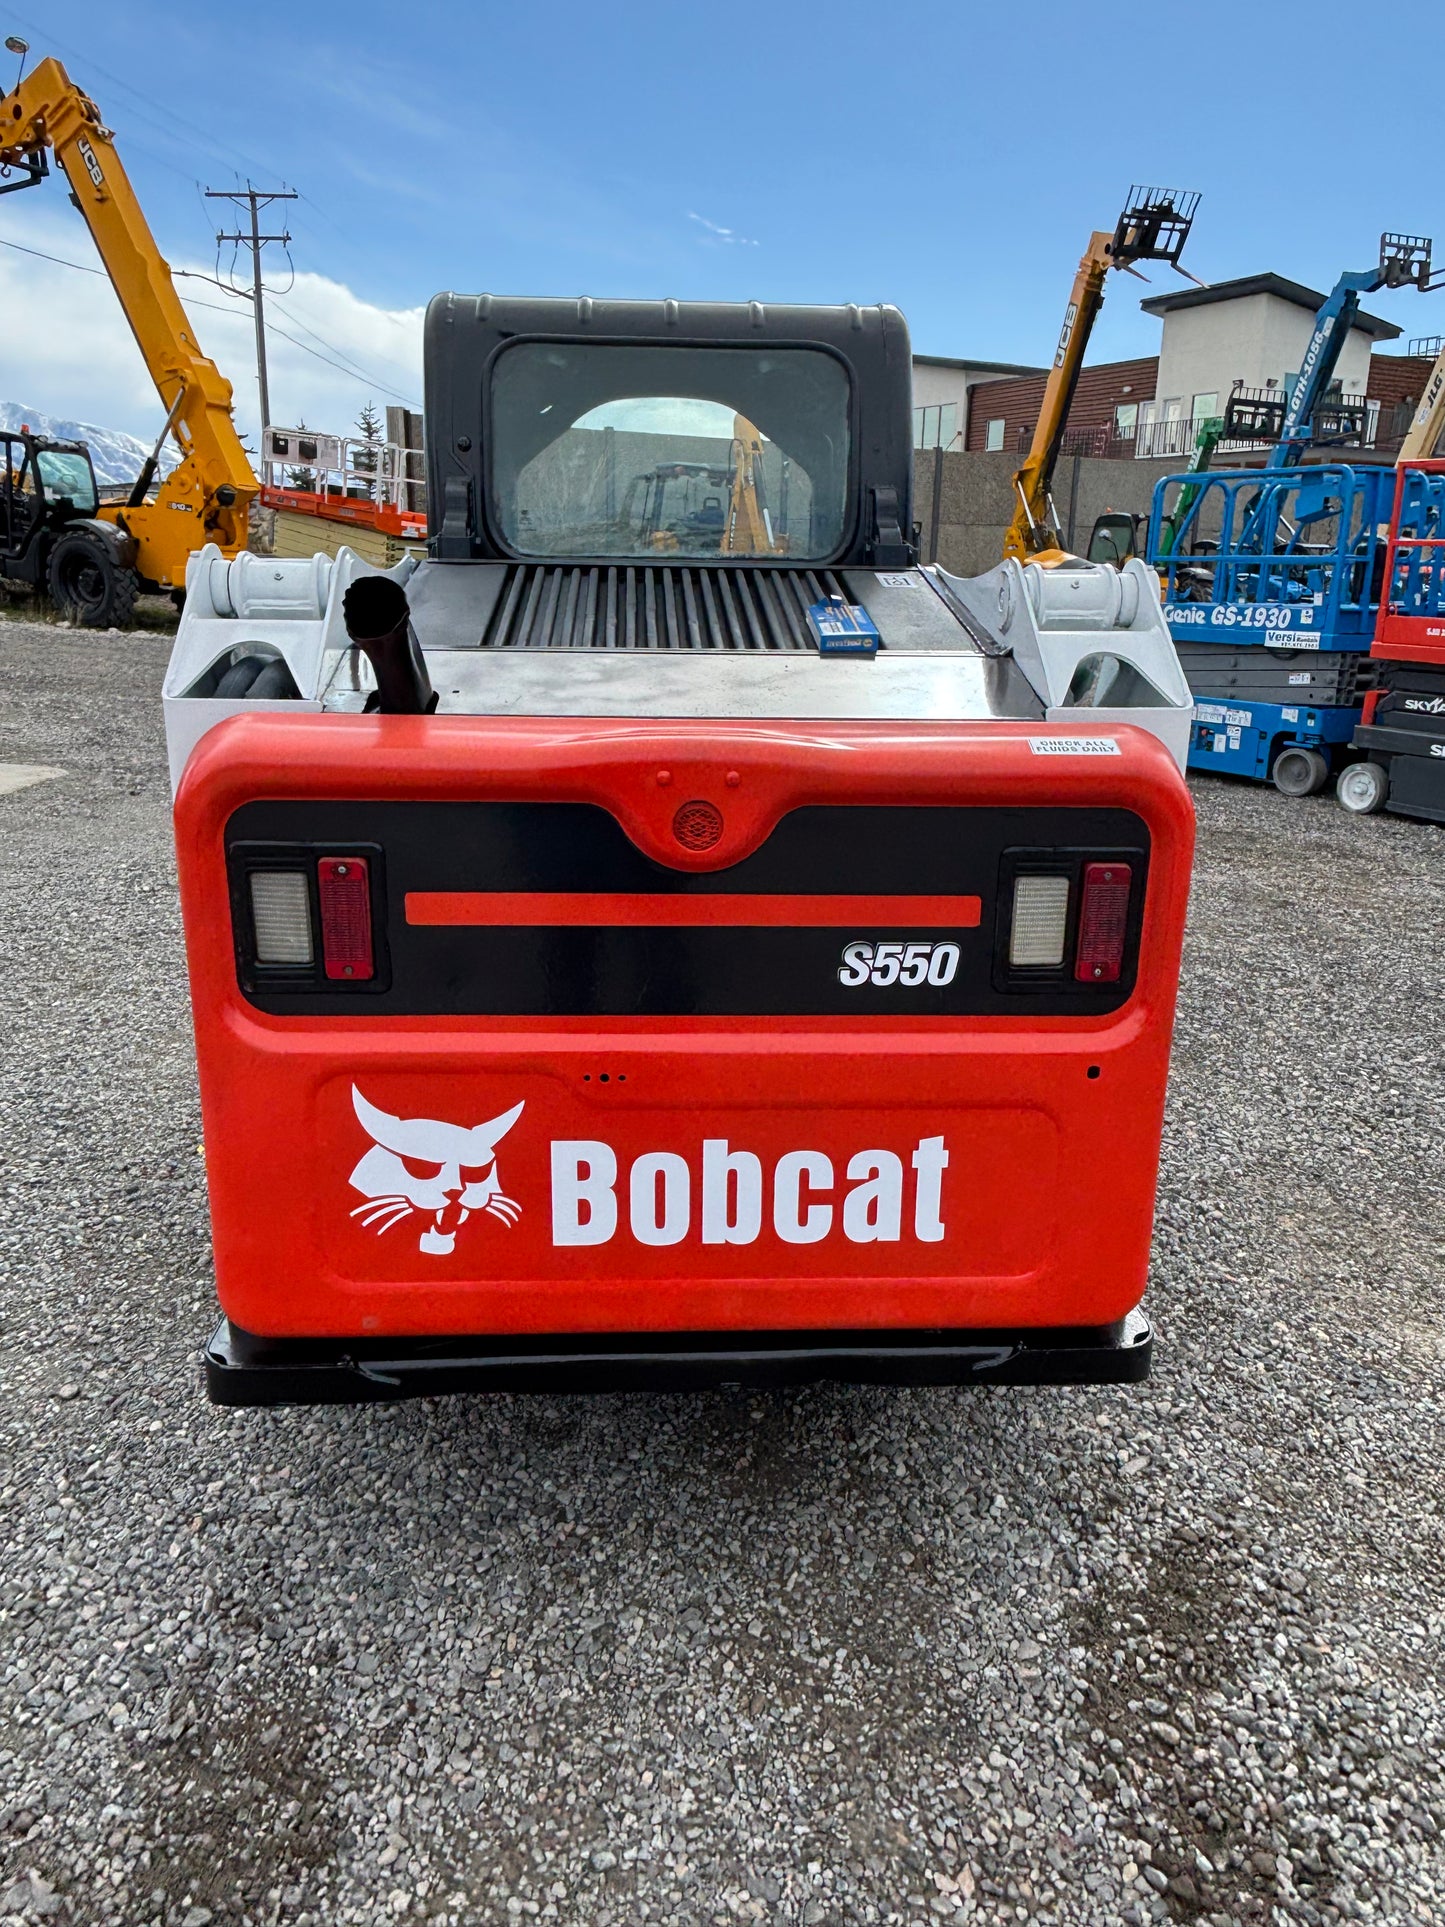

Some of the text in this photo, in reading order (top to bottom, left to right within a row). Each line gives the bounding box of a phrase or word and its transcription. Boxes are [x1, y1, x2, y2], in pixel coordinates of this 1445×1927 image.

[77, 138, 104, 186] JCB
[1054, 303, 1078, 368] JCB
[1290, 331, 1324, 411] GTH-1056
[1427, 374, 1443, 409] JLG
[1163, 605, 1292, 629] Genie GS-1930
[837, 941, 961, 987] S550
[550, 1135, 950, 1246] Bobcat
